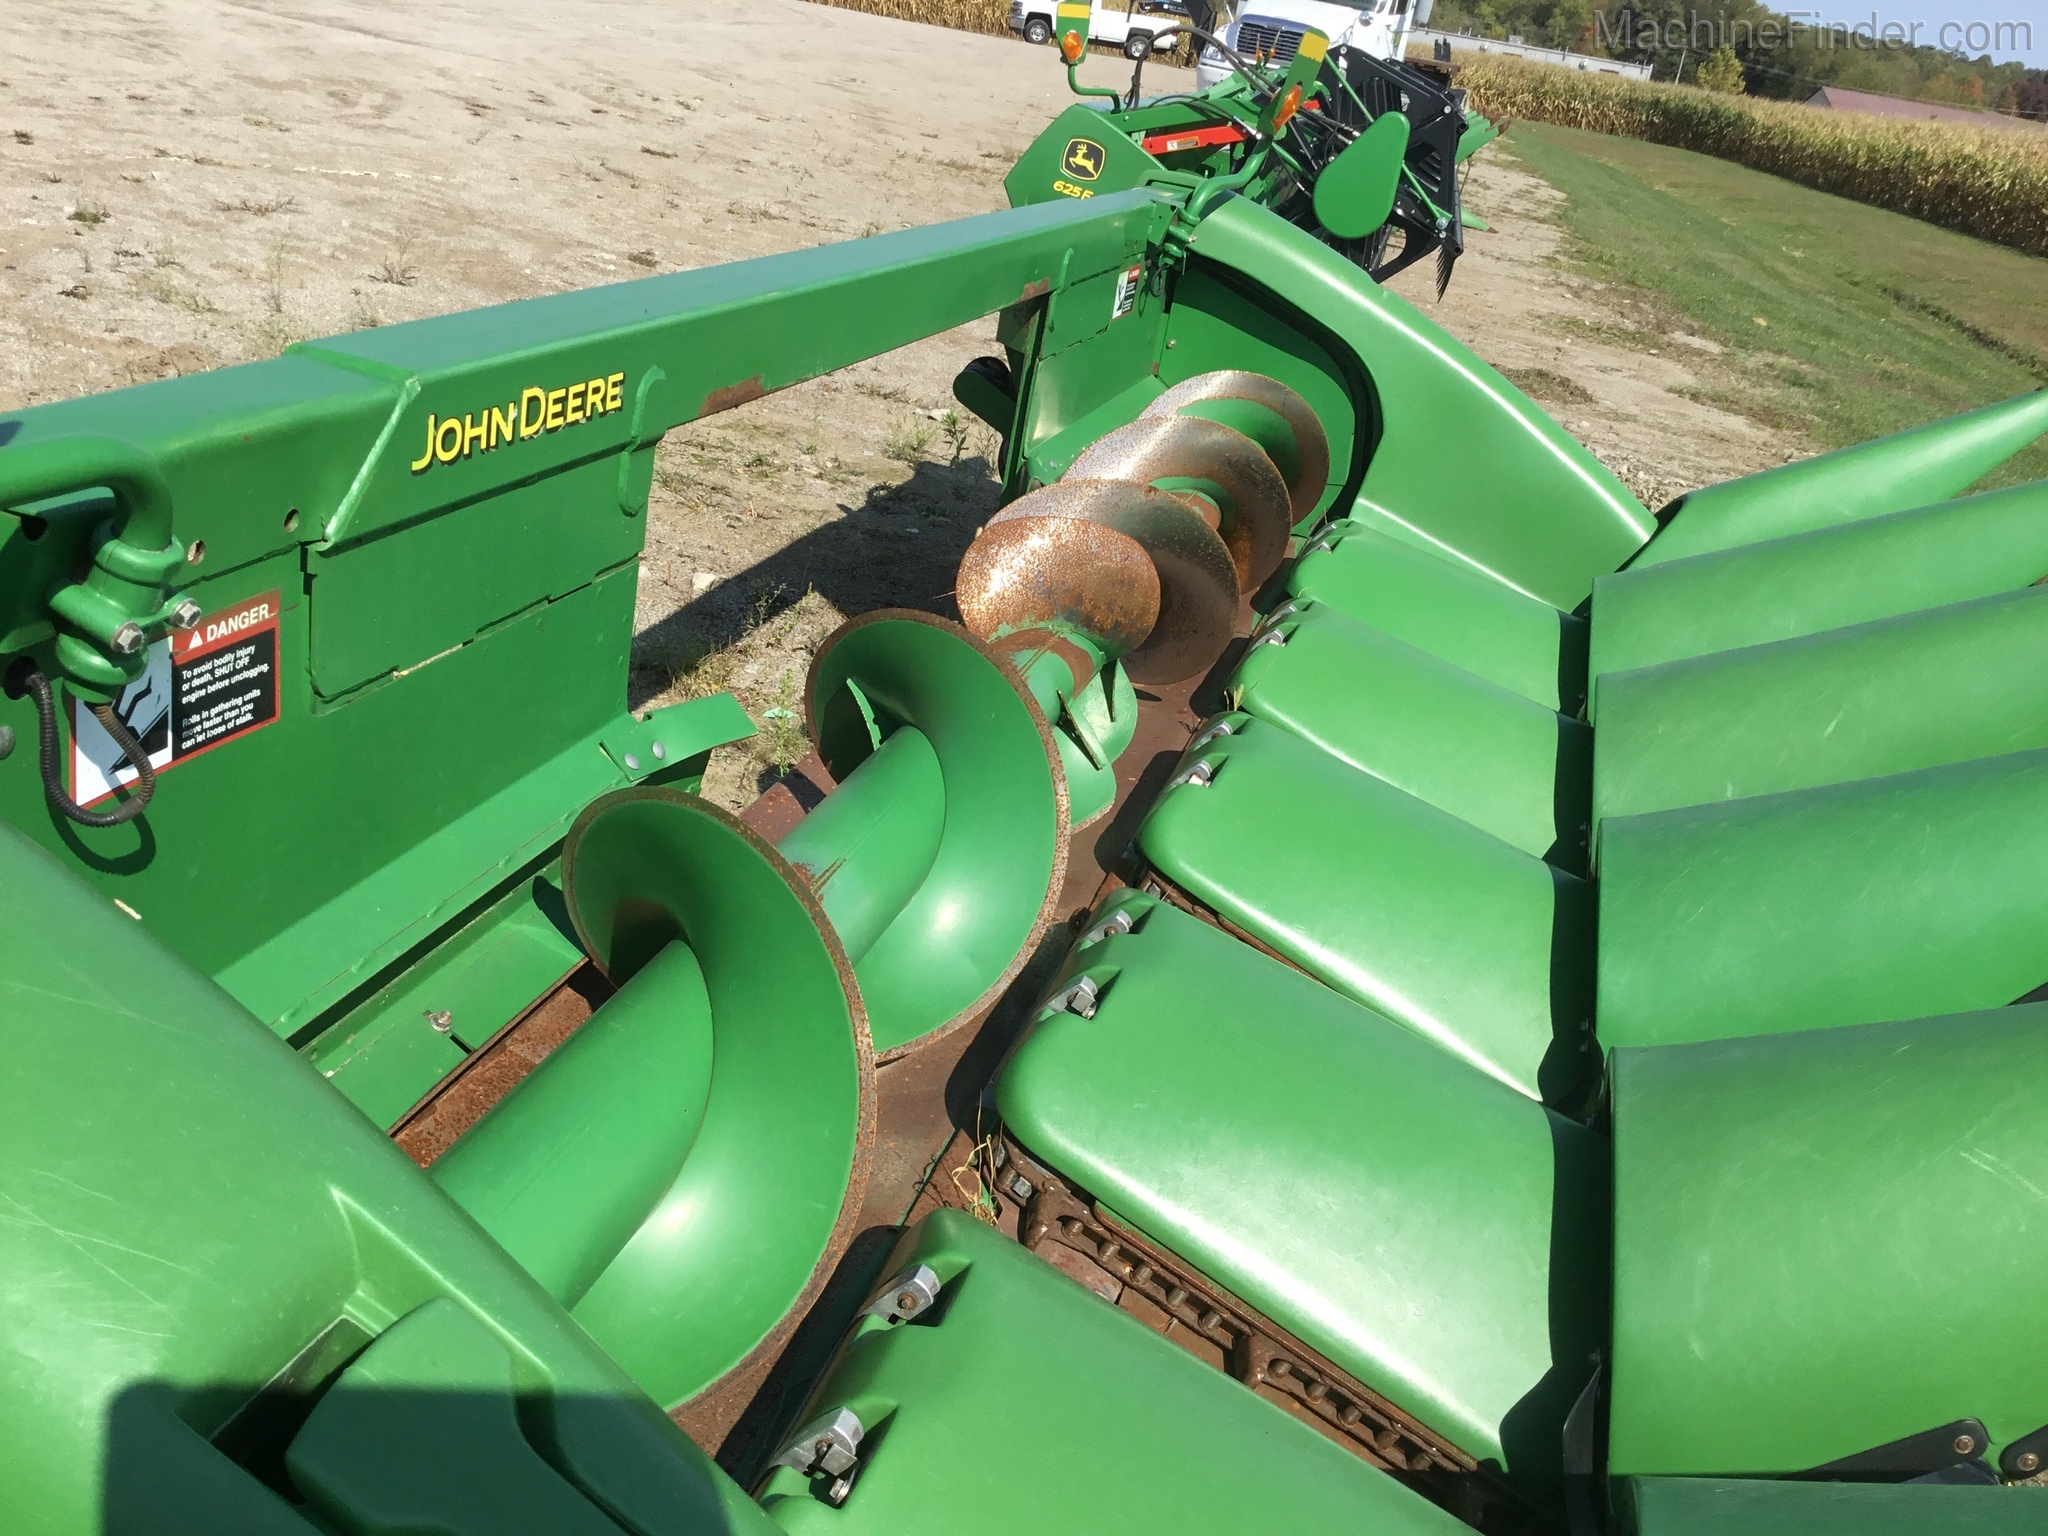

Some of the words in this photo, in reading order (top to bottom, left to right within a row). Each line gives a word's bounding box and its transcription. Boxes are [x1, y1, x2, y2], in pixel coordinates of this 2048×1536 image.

[411, 402, 517, 474] JOHN
[519, 371, 625, 440] DEERE
[206, 603, 269, 642] DANGER
[182, 670, 192, 680] To
[193, 661, 213, 676] avoid
[213, 652, 235, 668] bodily
[236, 645, 256, 659] injury
[182, 683, 190, 692] or
[191, 673, 214, 688] death,
[214, 662, 235, 678] SHUT
[235, 656, 250, 670] OFF
[181, 688, 207, 705] engine
[207, 679, 230, 694] before
[230, 663, 270, 683] unclogging.
[182, 713, 201, 728] Rolls
[201, 709, 209, 720] in
[209, 697, 243, 716] gathering
[243, 689, 261, 702] units
[182, 724, 202, 739] move
[202, 714, 224, 730] faster
[223, 707, 240, 721] than
[240, 702, 254, 716] you
[181, 736, 196, 750] can
[196, 732, 206, 743] let
[206, 723, 227, 739] loose
[226, 719, 235, 730] of
[235, 712, 254, 726] stalk.
[1206, 1281, 1224, 1297] USA
[1226, 1294, 1236, 1306] IN
[1240, 1303, 1264, 1323] MADE
